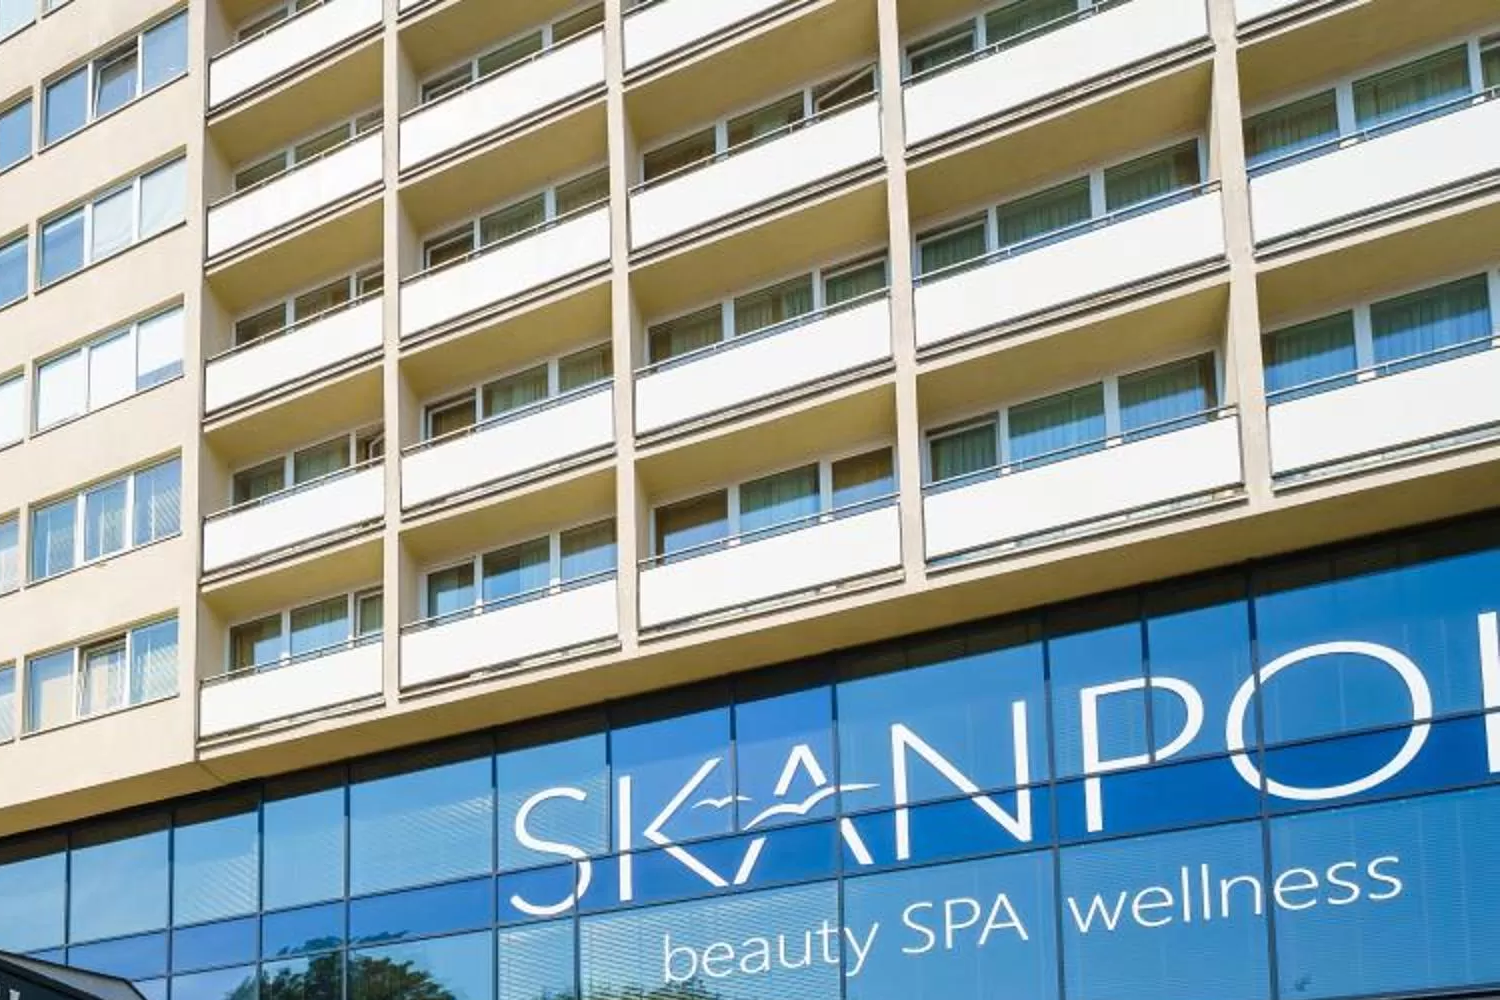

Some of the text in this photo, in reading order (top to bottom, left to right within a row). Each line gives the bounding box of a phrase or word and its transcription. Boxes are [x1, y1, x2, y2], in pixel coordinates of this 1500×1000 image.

[662, 856, 1403, 984] beauty SPA wellness
